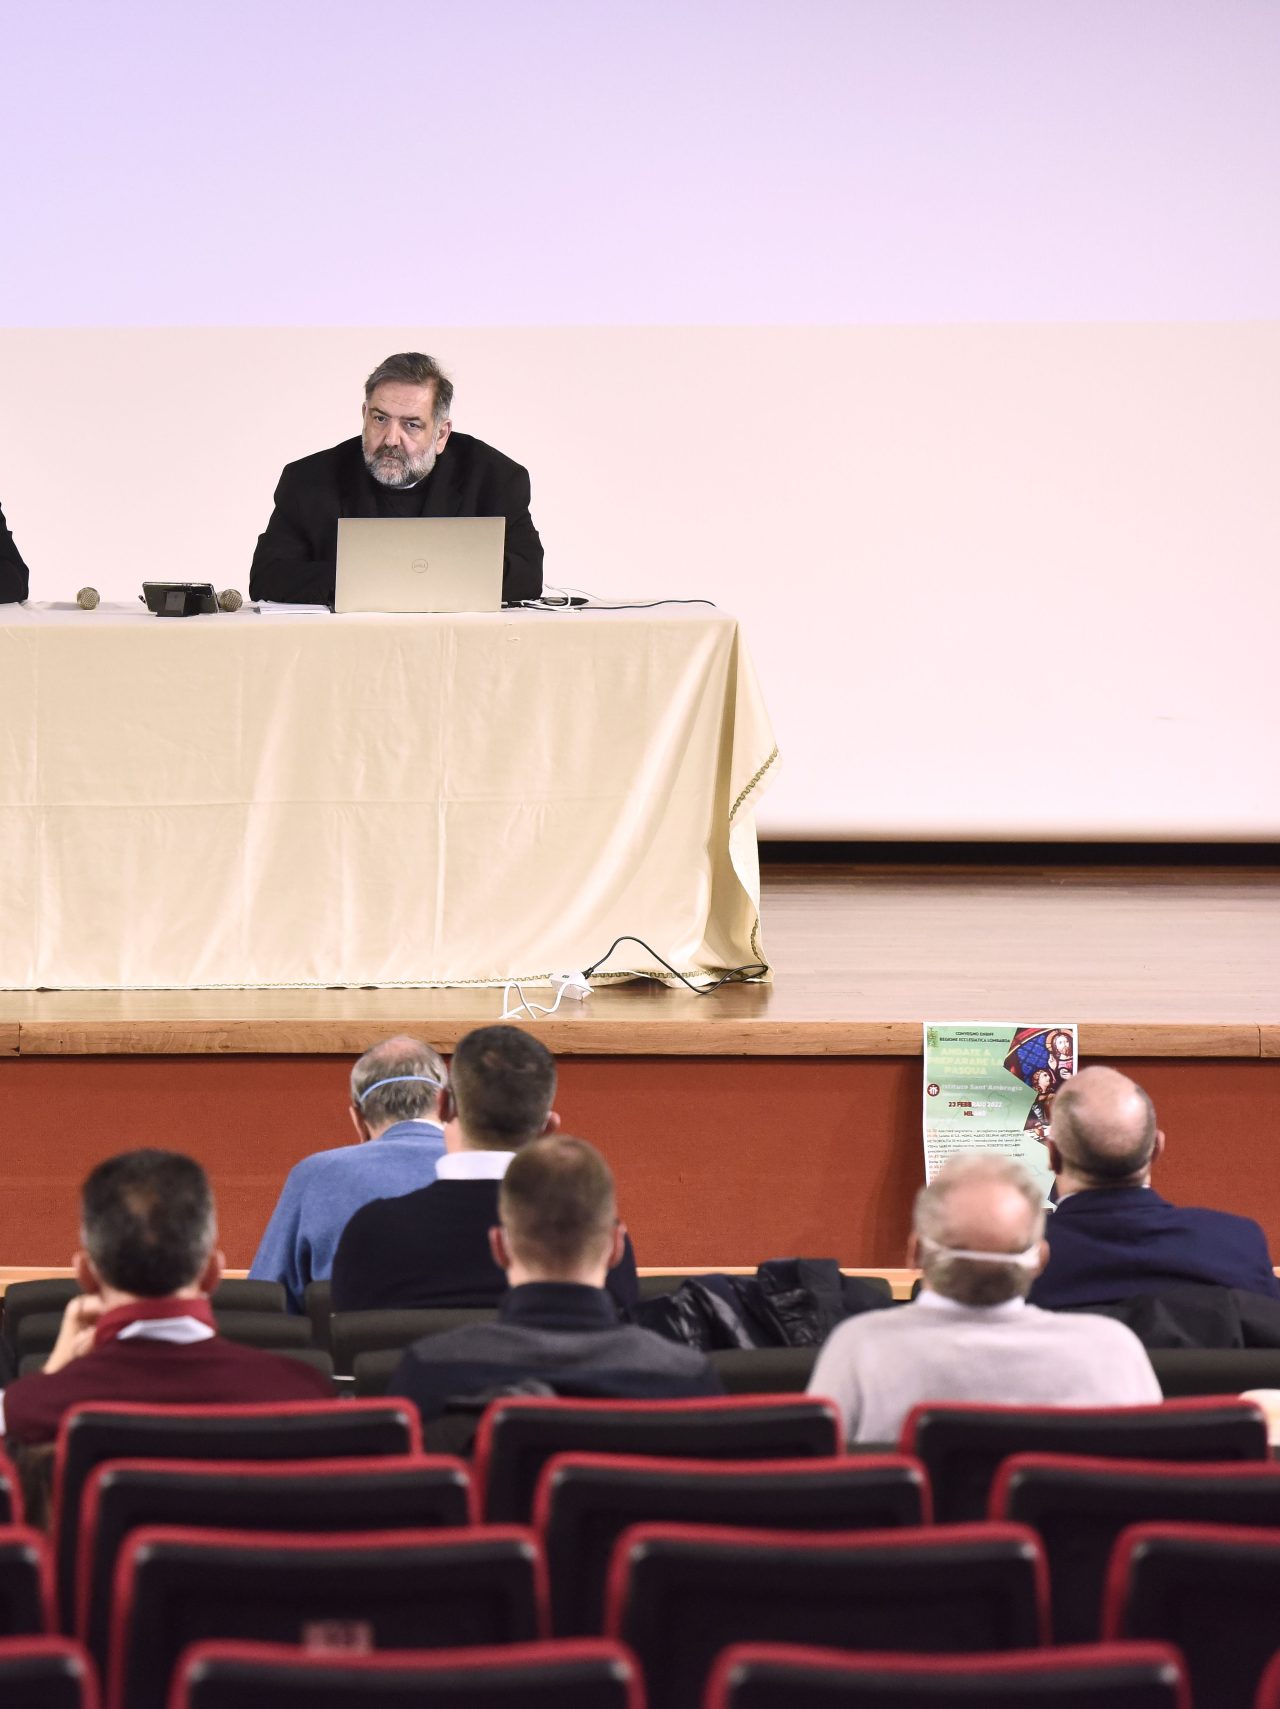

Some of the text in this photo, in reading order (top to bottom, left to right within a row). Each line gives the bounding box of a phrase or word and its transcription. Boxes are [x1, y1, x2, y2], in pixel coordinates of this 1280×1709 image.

[940, 1048, 980, 1056] ANDATE
[928, 1057, 1003, 1066] PREPARARE LA
[944, 1067, 987, 1075] PASQUA
[970, 1084, 1023, 1092] Sant'Ambrogio
